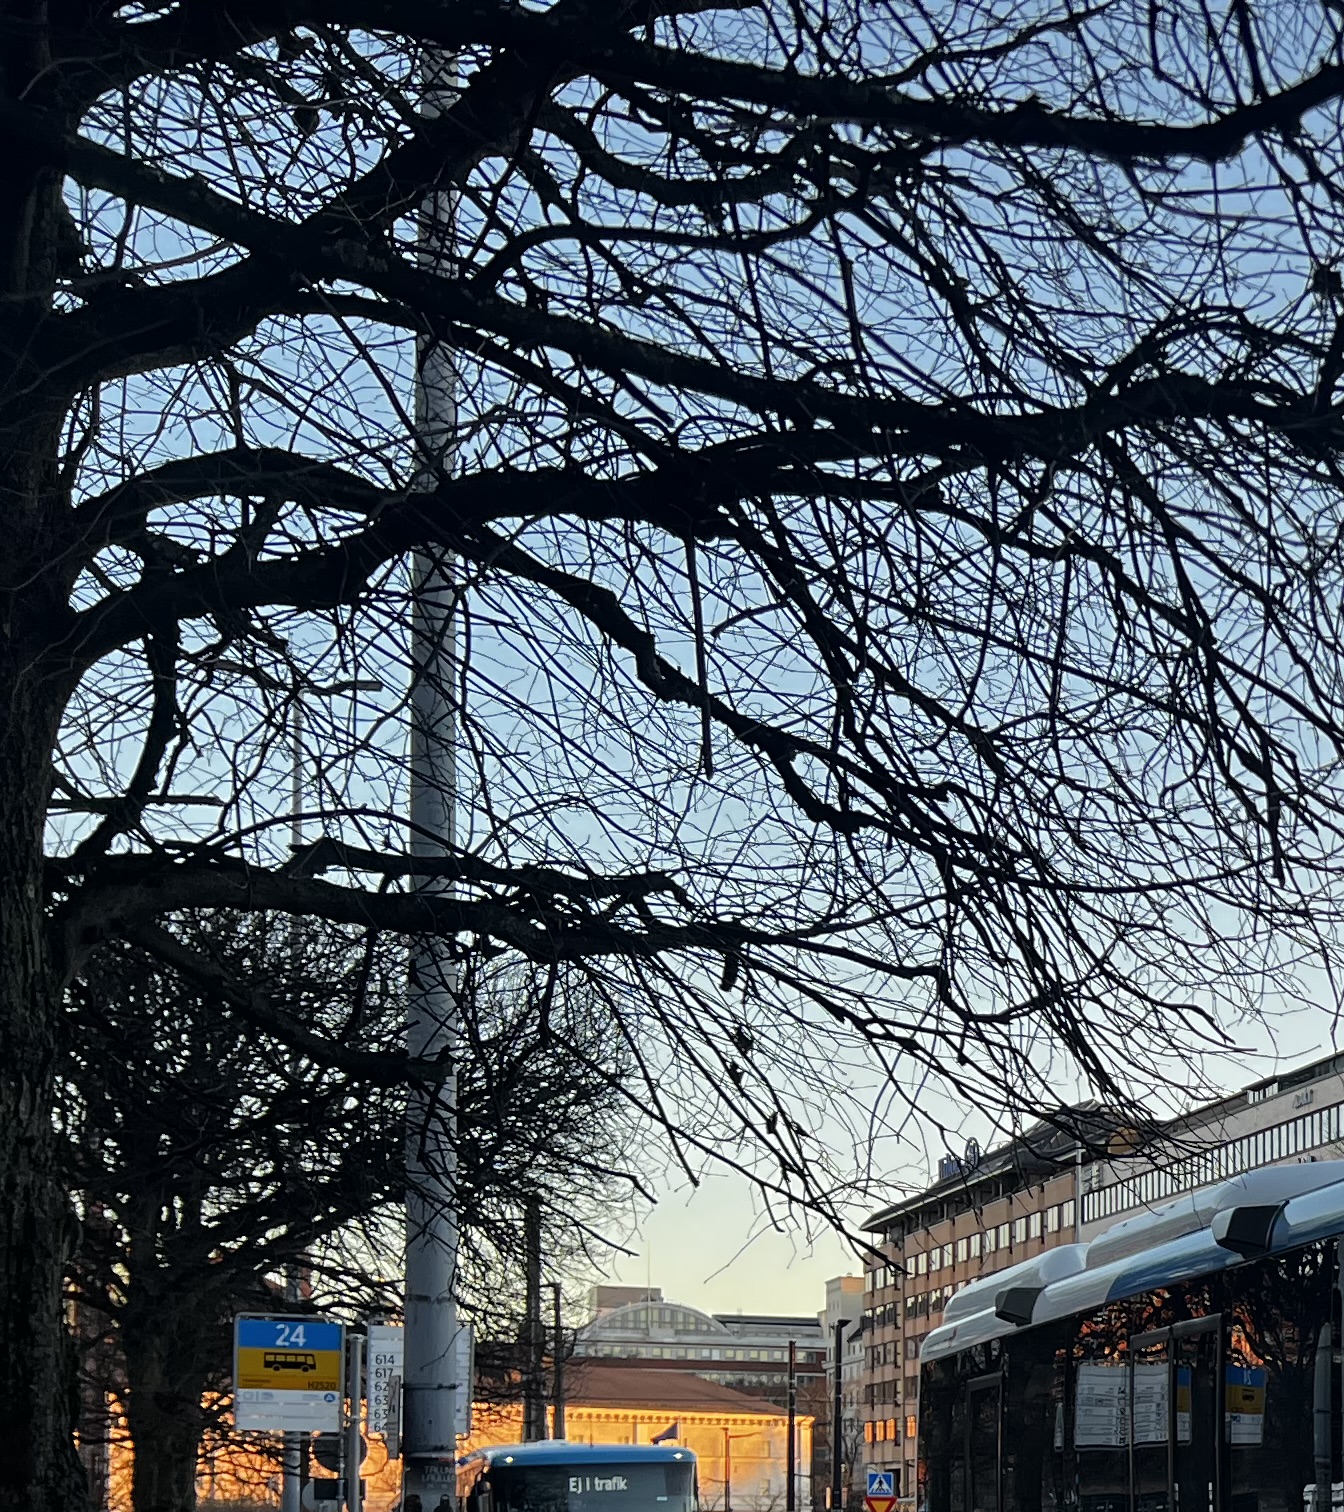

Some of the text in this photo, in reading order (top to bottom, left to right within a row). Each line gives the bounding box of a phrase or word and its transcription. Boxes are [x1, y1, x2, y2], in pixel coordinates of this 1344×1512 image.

[274, 1323, 307, 1347] 24
[375, 1353, 395, 1365] 614
[375, 1367, 394, 1379] 617
[374, 1381, 389, 1392] 62
[374, 1394, 389, 1405] 63
[374, 1408, 389, 1419] 63
[568, 1476, 583, 1494] Ej
[594, 1475, 628, 1491] trafik
